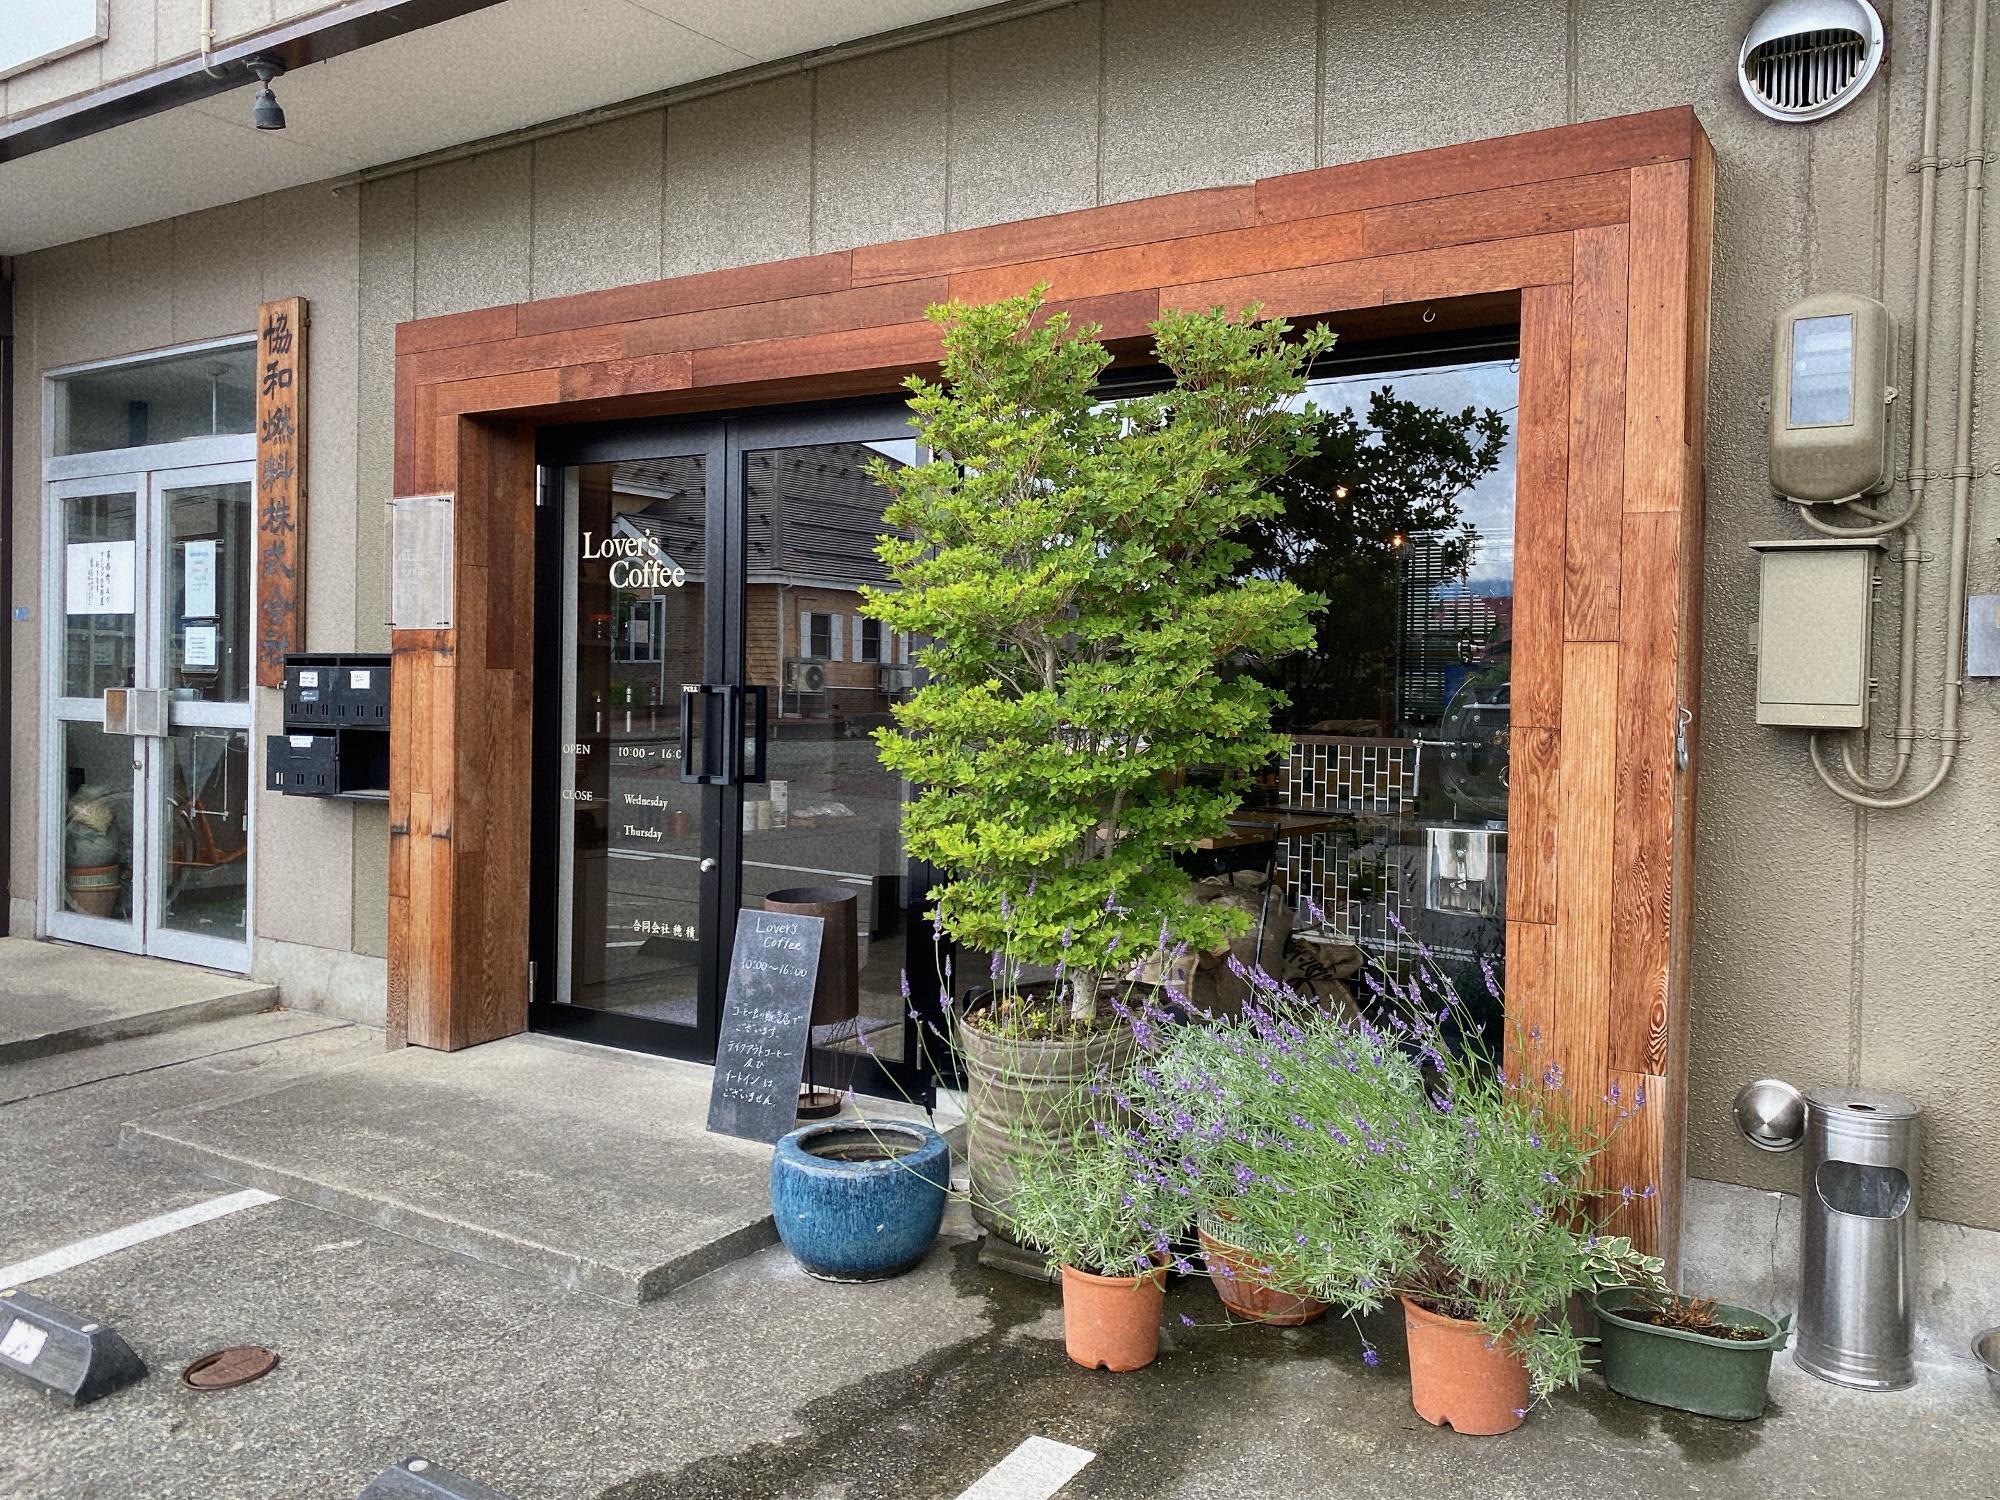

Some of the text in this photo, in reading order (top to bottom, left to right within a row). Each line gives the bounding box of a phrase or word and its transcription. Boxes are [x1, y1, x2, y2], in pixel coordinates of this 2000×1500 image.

[582, 529, 659, 559] Lover's
[609, 560, 686, 588] Coffee
[562, 744, 591, 755] OPEN
[618, 747, 645, 758] 10:00
[562, 789, 593, 801] CLOSE
[624, 794, 668, 811] Wednesday
[624, 825, 663, 842] Thursday
[755, 917, 798, 935] Lover's
[763, 937, 802, 951] Coffee
[743, 1058, 768, 1069] 及び
